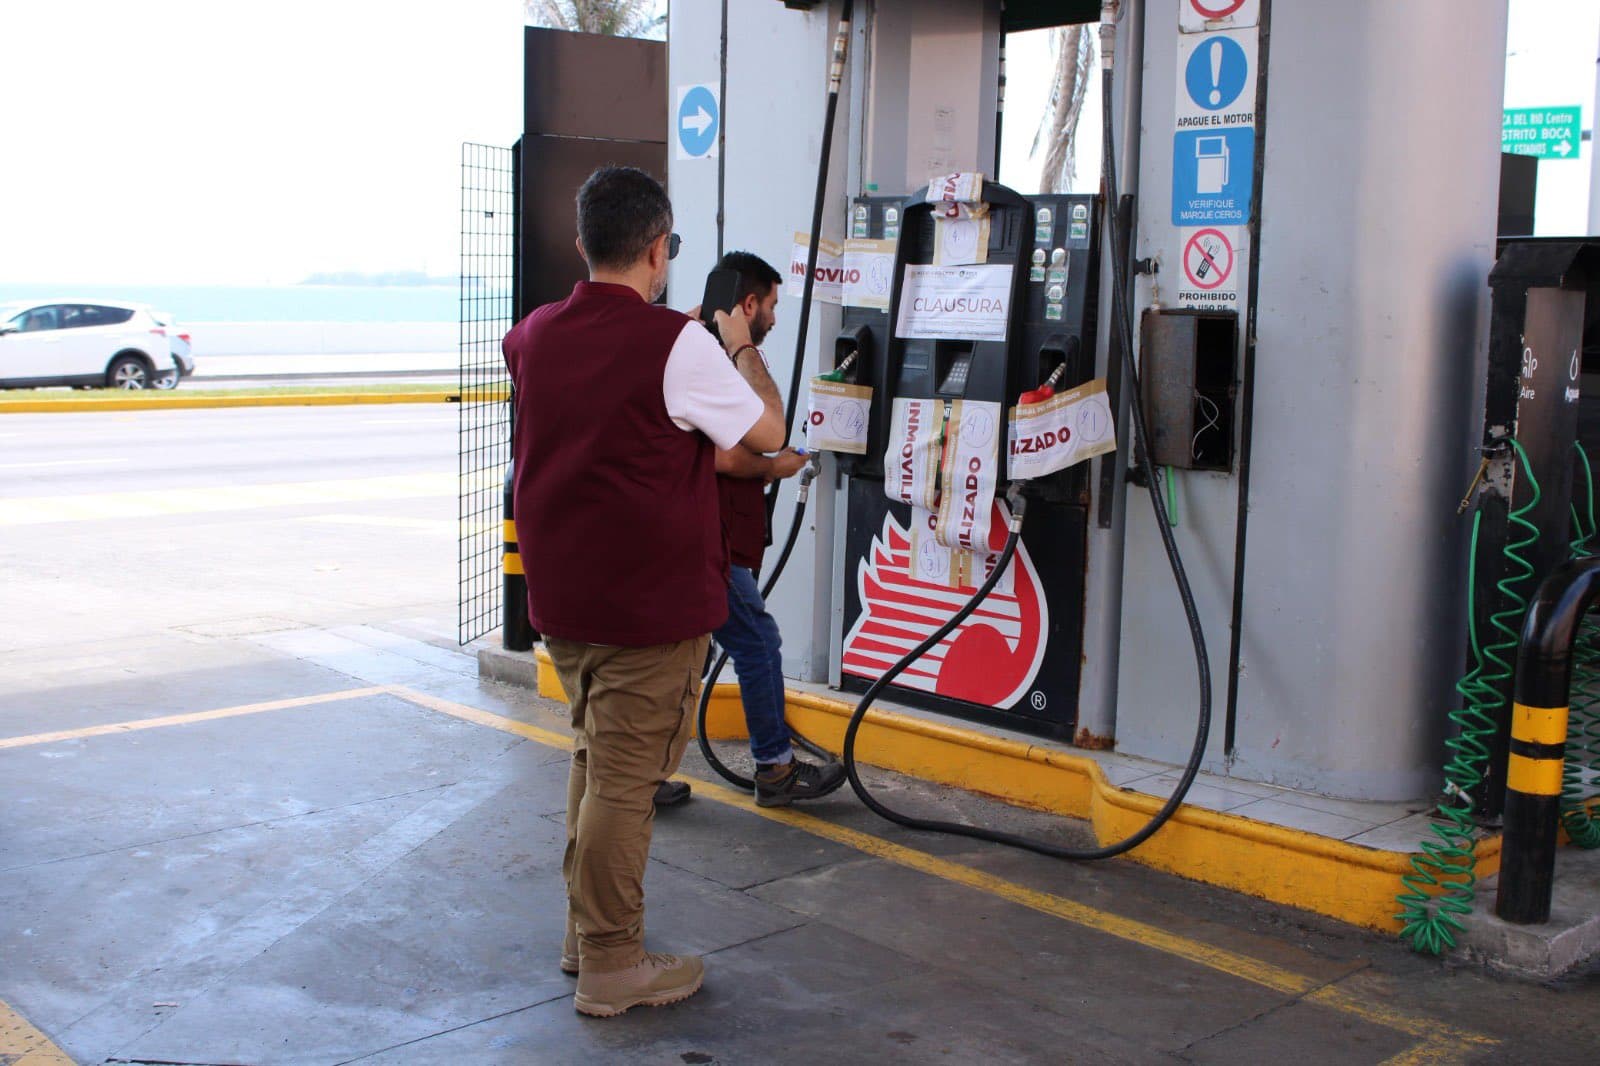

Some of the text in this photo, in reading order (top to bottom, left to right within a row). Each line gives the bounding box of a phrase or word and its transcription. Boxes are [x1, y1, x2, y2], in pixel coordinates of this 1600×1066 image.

[1177, 113, 1253, 127] APAGUE EL MOTOR
[1541, 127, 1572, 139] BOCA
[1188, 199, 1235, 209] VERIFIQUE
[1180, 209, 1242, 220] MARQUE CEROS
[1178, 292, 1237, 301] PROHIBIDO
[913, 297, 1004, 313] CLAUSURA
[1520, 386, 1535, 400] Aire
